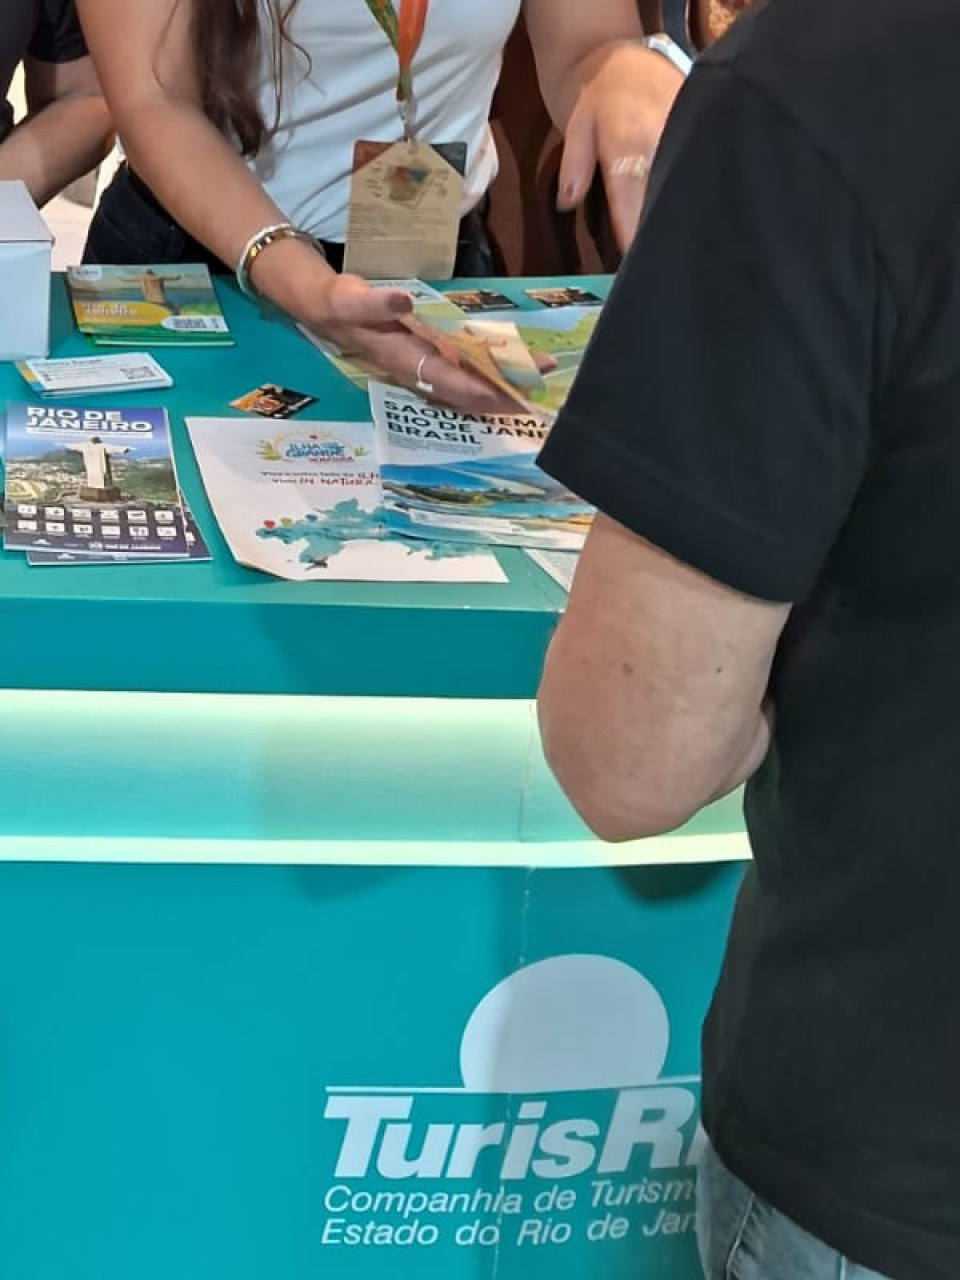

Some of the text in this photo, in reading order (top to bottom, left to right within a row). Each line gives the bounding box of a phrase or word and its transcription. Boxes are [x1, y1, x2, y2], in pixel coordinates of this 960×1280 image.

[26, 407, 122, 422] RIO DE
[26, 418, 153, 433] JANEIRO
[385, 410, 431, 428] RIO
[439, 421, 473, 434] DE
[388, 421, 482, 445] BRASIL
[322, 1086, 701, 1180] TurisR
[323, 1177, 697, 1219] Companhia de Turism
[320, 1218, 439, 1246] Estado
[454, 1219, 501, 1247] do
[516, 1221, 572, 1247] Rio
[586, 1215, 630, 1242] de
